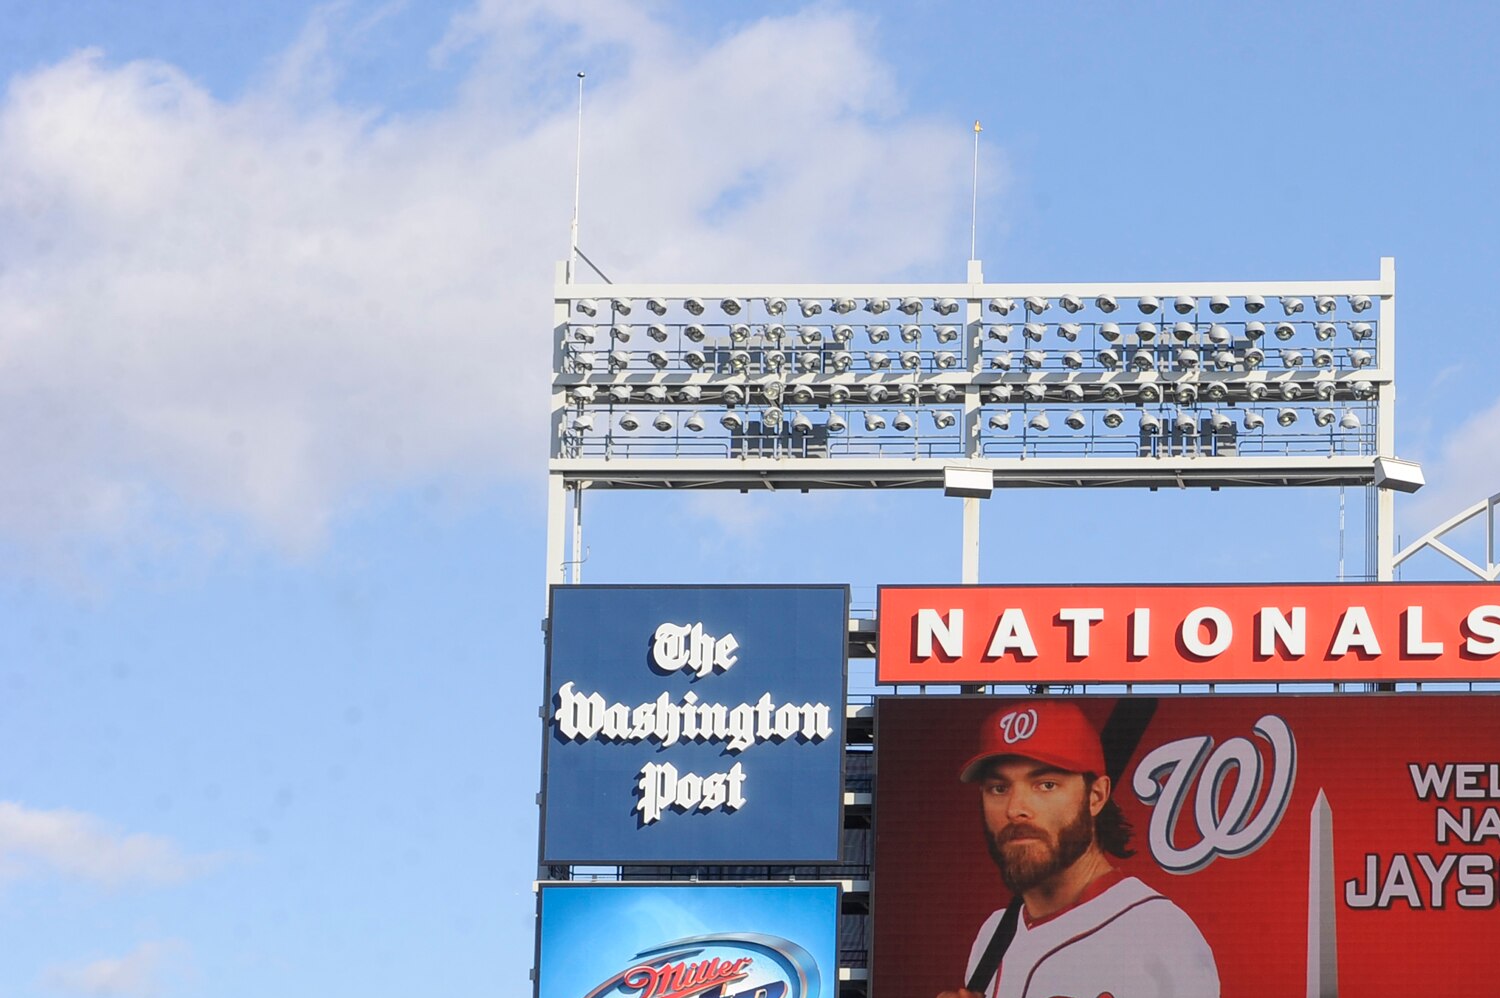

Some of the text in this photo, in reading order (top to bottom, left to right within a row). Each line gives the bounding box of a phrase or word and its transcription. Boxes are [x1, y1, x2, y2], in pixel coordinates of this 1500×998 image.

[653, 622, 740, 678] The
[555, 681, 834, 751] Washington
[637, 761, 747, 824] Post
